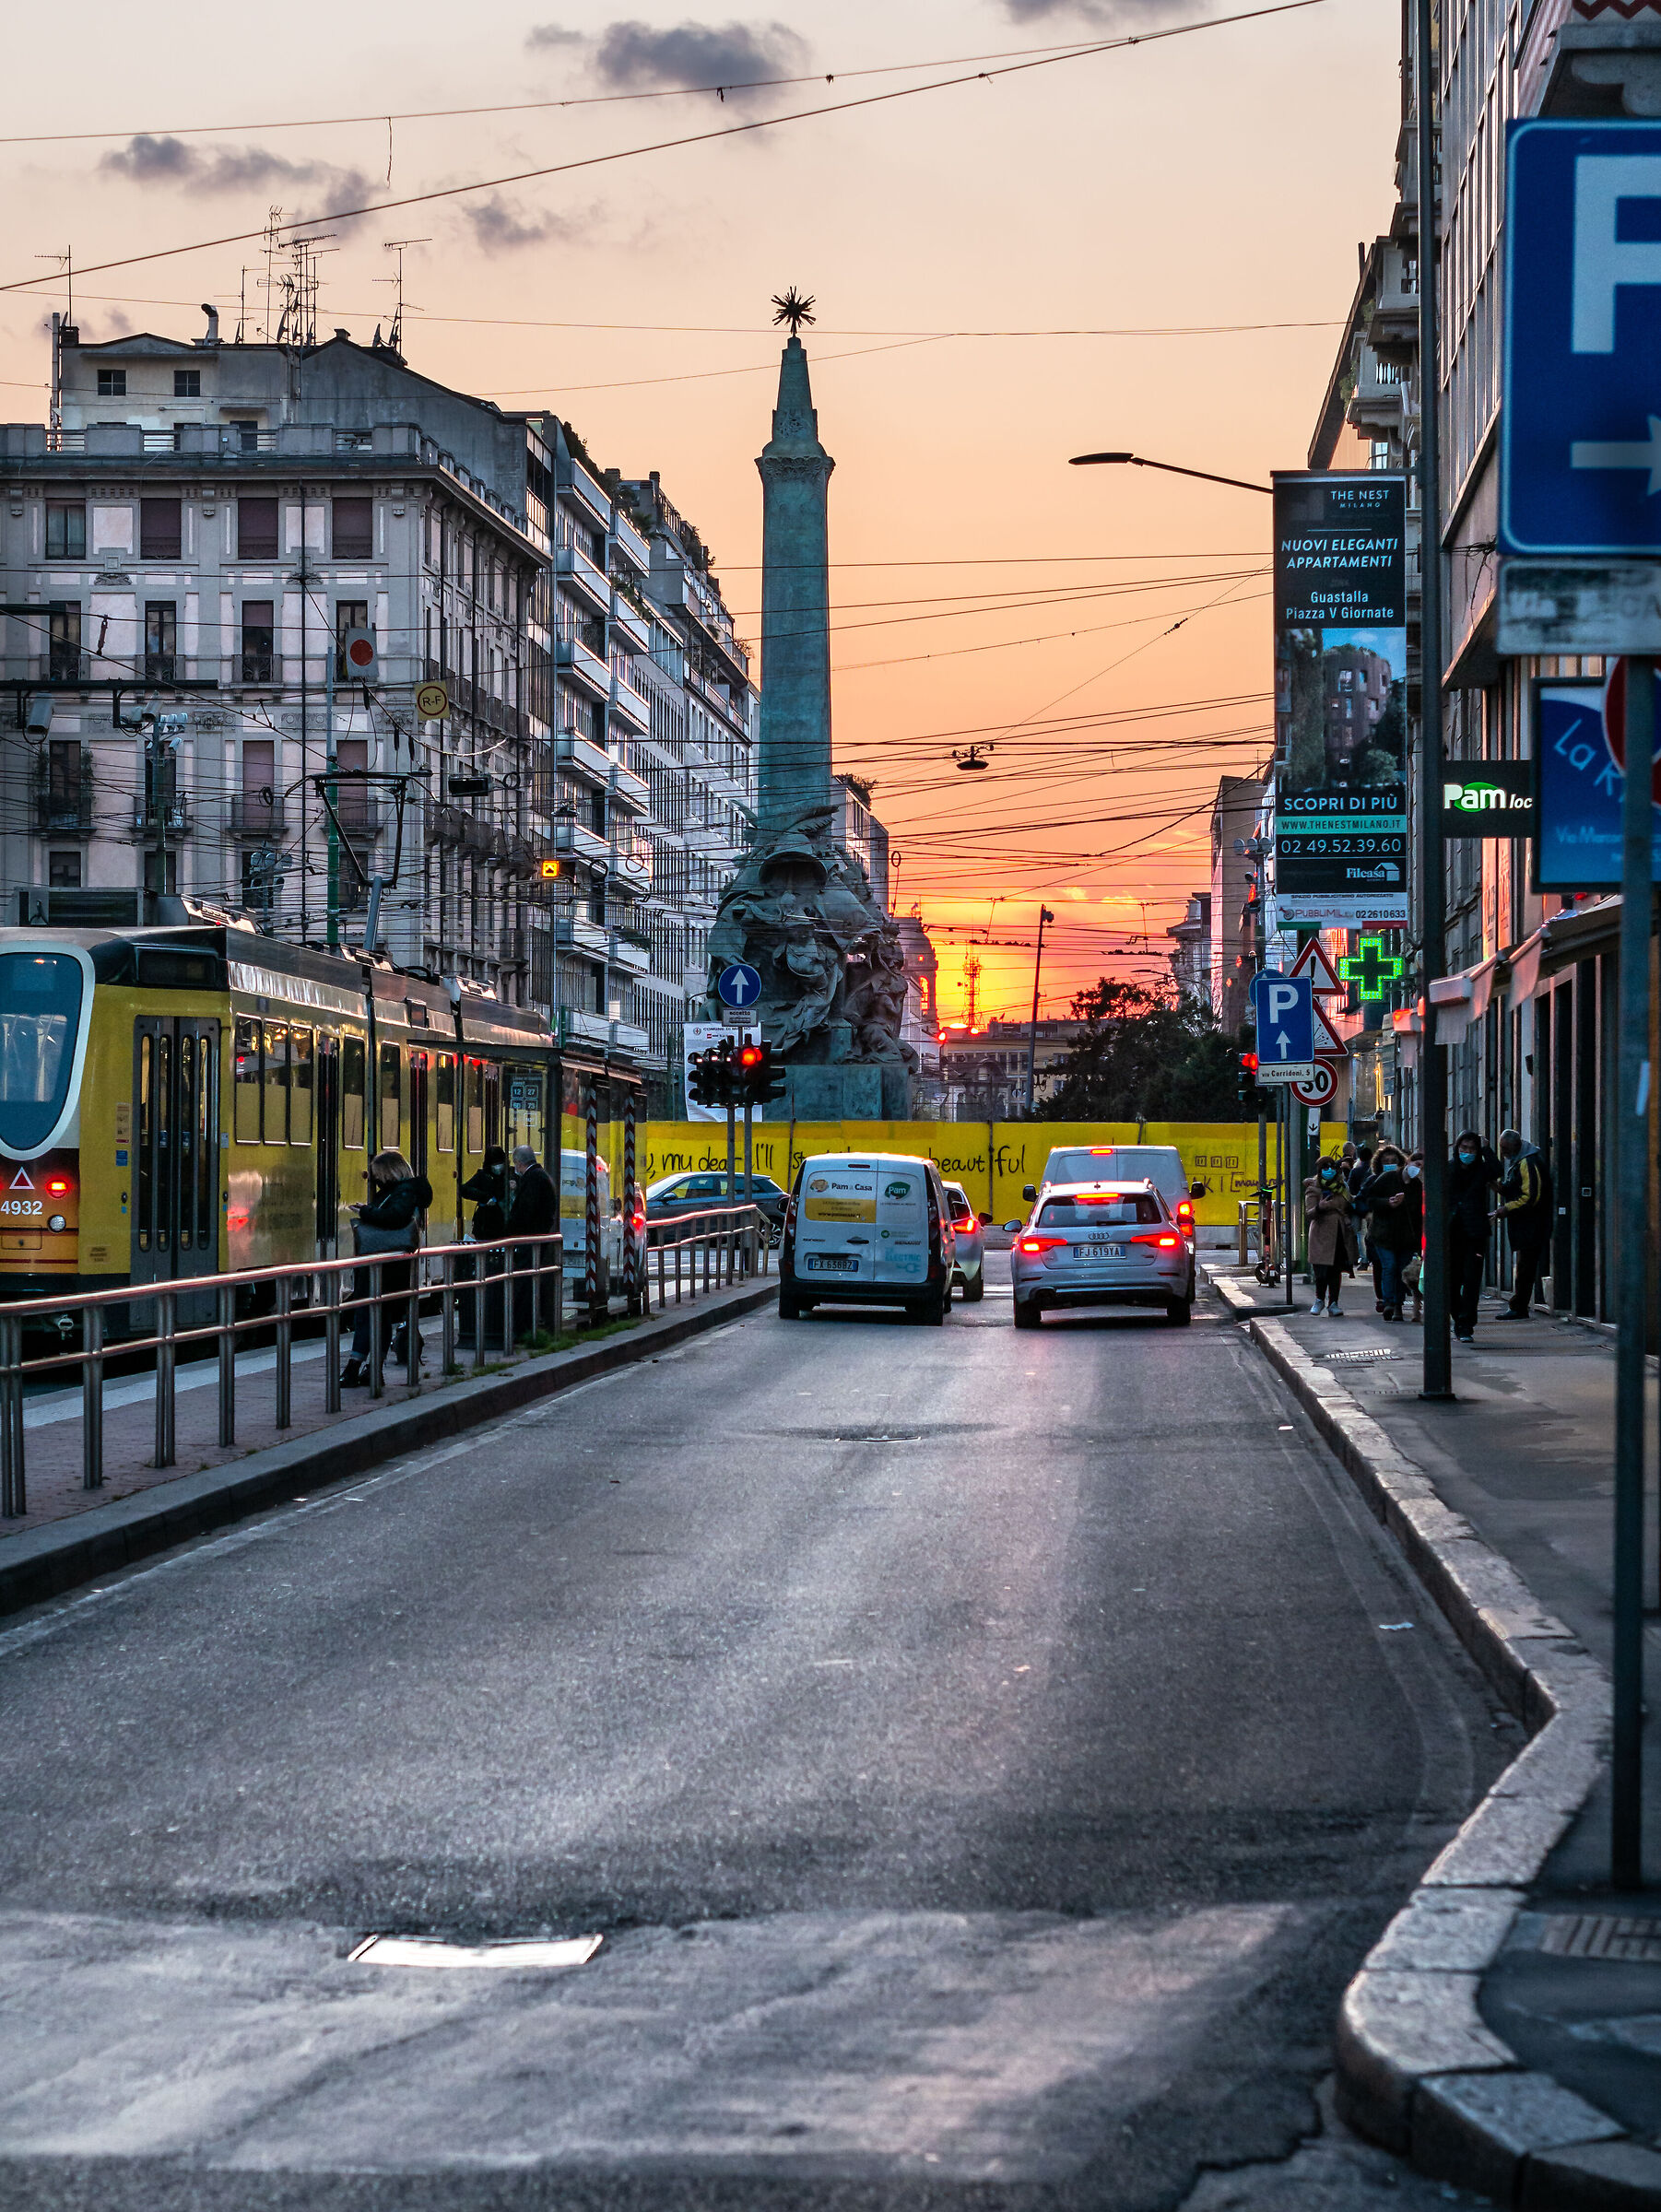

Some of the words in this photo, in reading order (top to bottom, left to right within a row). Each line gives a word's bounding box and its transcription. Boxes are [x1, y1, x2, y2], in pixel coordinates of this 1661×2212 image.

[1330, 490, 1354, 500] THE
[1359, 489, 1390, 500] NEST
[1281, 539, 1327, 552] NUOVI
[1331, 537, 1399, 551] ELEGANTI
[1286, 555, 1393, 569] APPARTAMENTI
[1310, 591, 1369, 604] Guastalla
[1286, 607, 1325, 620] Piazza
[1329, 607, 1337, 619] V
[1341, 606, 1395, 619] Giornate
[422, 695, 442, 707] R-F
[1284, 798, 1344, 811] SCOPRI
[1349, 797, 1366, 810] DI
[1371, 793, 1398, 810] PIÙ
[1443, 783, 1507, 810] Pam
[1281, 819, 1401, 830] WWW.THENESTMILANO.IT
[1281, 840, 1302, 853] 02
[1306, 839, 1402, 853] 49.52.39.60
[1346, 866, 1385, 878] Filcasa
[1268, 984, 1300, 1024] P
[831, 1182, 849, 1191] Pam
[854, 1183, 873, 1192] Casa
[888, 1186, 907, 1195] Pam
[1, 1200, 43, 1216] 4932
[1078, 1247, 1090, 1258] FJ
[1092, 1247, 1120, 1257] 619YA
[813, 1260, 824, 1269] FX
